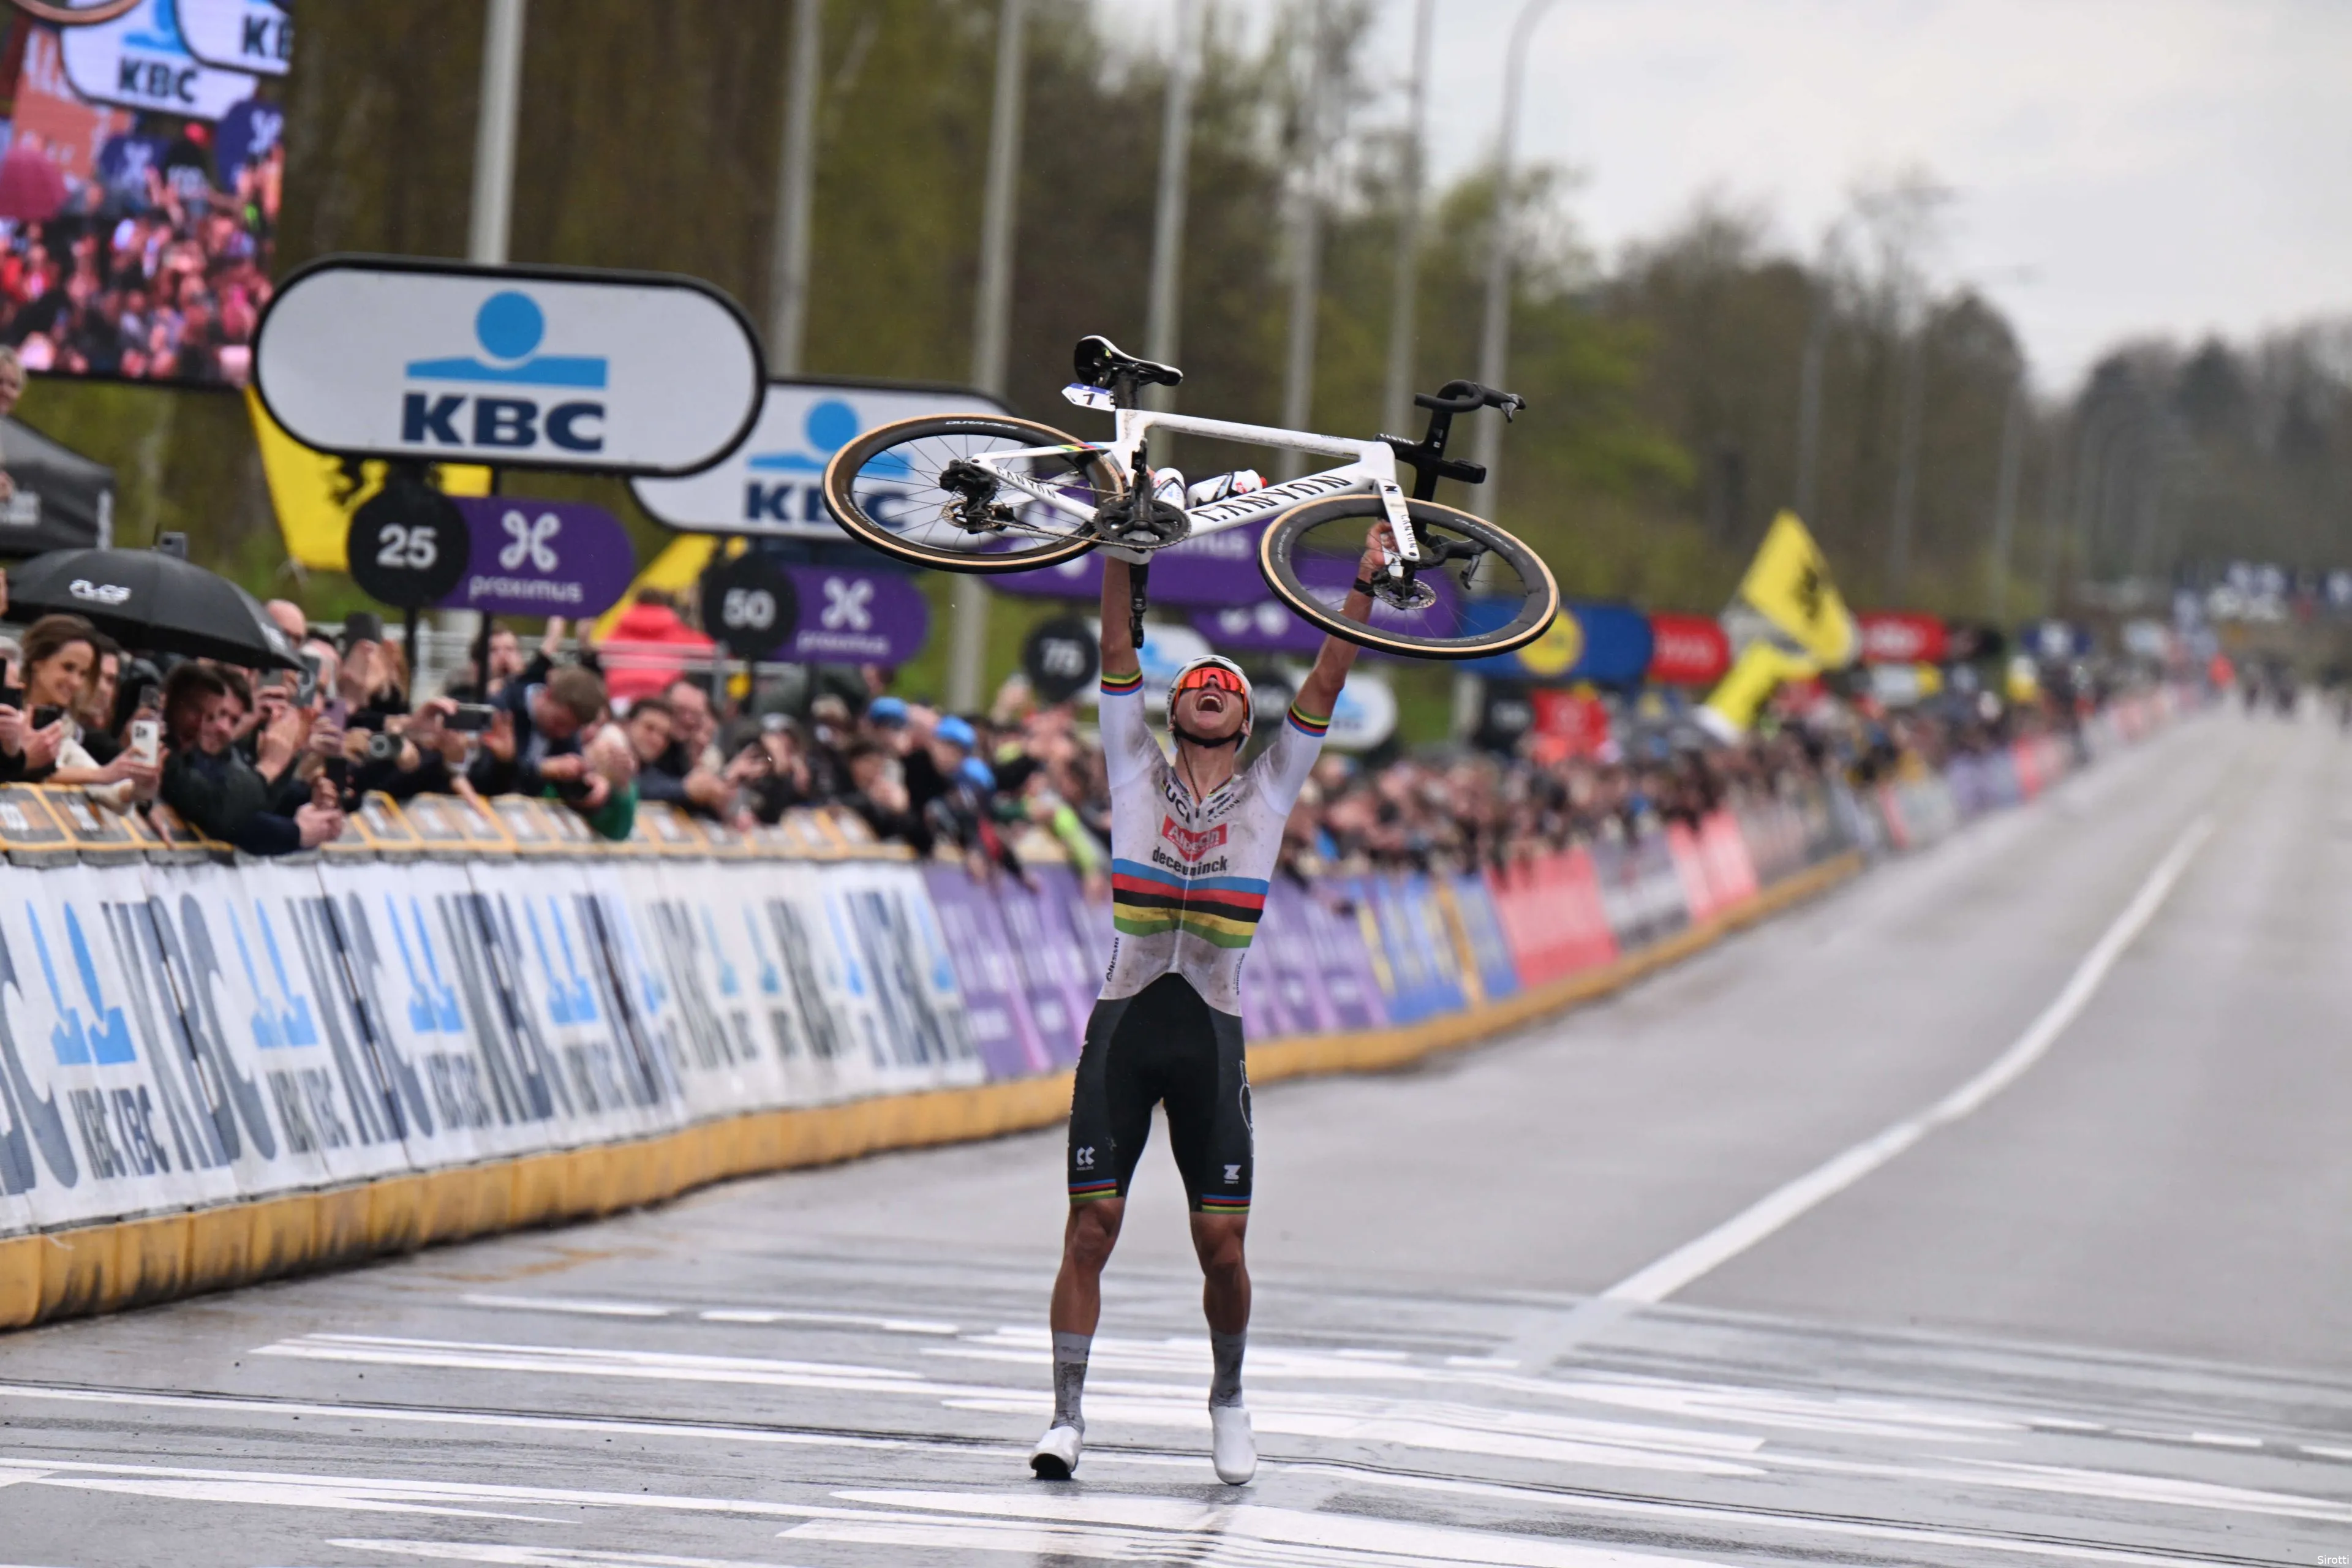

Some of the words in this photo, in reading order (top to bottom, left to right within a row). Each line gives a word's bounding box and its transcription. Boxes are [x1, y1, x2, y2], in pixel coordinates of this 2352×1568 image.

[119, 59, 198, 103] KBC
[1083, 393, 1095, 405] 1
[400, 391, 605, 452] KBC
[996, 466, 1056, 499] CANYON
[1191, 475, 1352, 522] CANYON
[377, 524, 437, 569] 25
[1401, 514, 1416, 548] CANYON
[468, 575, 583, 604] proximus
[723, 588, 775, 631] 50
[1165, 783, 1191, 824] UCI
[1152, 846, 1227, 876] deceuninck
